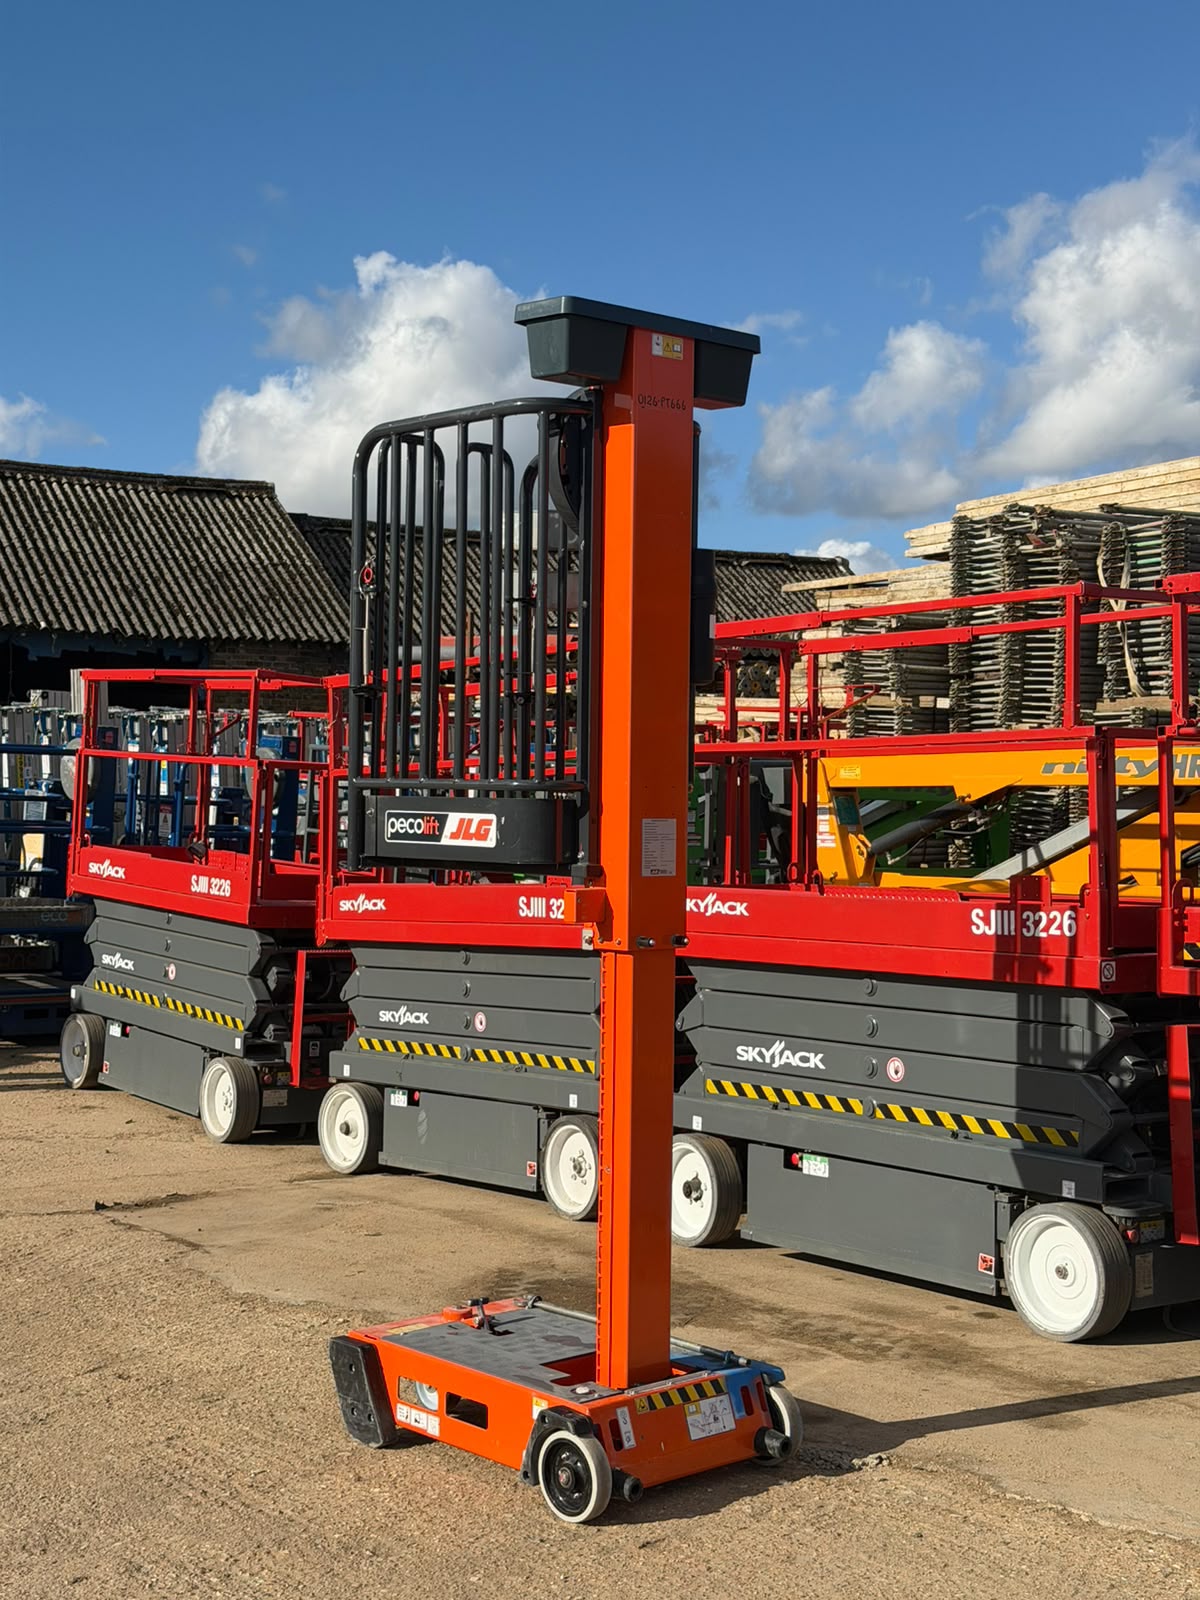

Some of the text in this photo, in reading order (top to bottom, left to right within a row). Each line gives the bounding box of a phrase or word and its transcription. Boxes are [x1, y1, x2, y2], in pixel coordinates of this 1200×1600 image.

[1041, 755, 1159, 778] nity
[387, 816, 494, 842] pecolift JLG
[88, 859, 126, 879] SKYJACK
[190, 875, 231, 897] SJIII 3226
[339, 893, 386, 913] SKYJACK
[518, 896, 565, 919] SJIII 32
[686, 892, 750, 917] KYJACK
[970, 908, 1077, 938] SJIII 3226
[101, 951, 135, 971] SKYJACK
[378, 1004, 430, 1026] SKYJACK
[735, 1039, 827, 1070] SKYJACK
